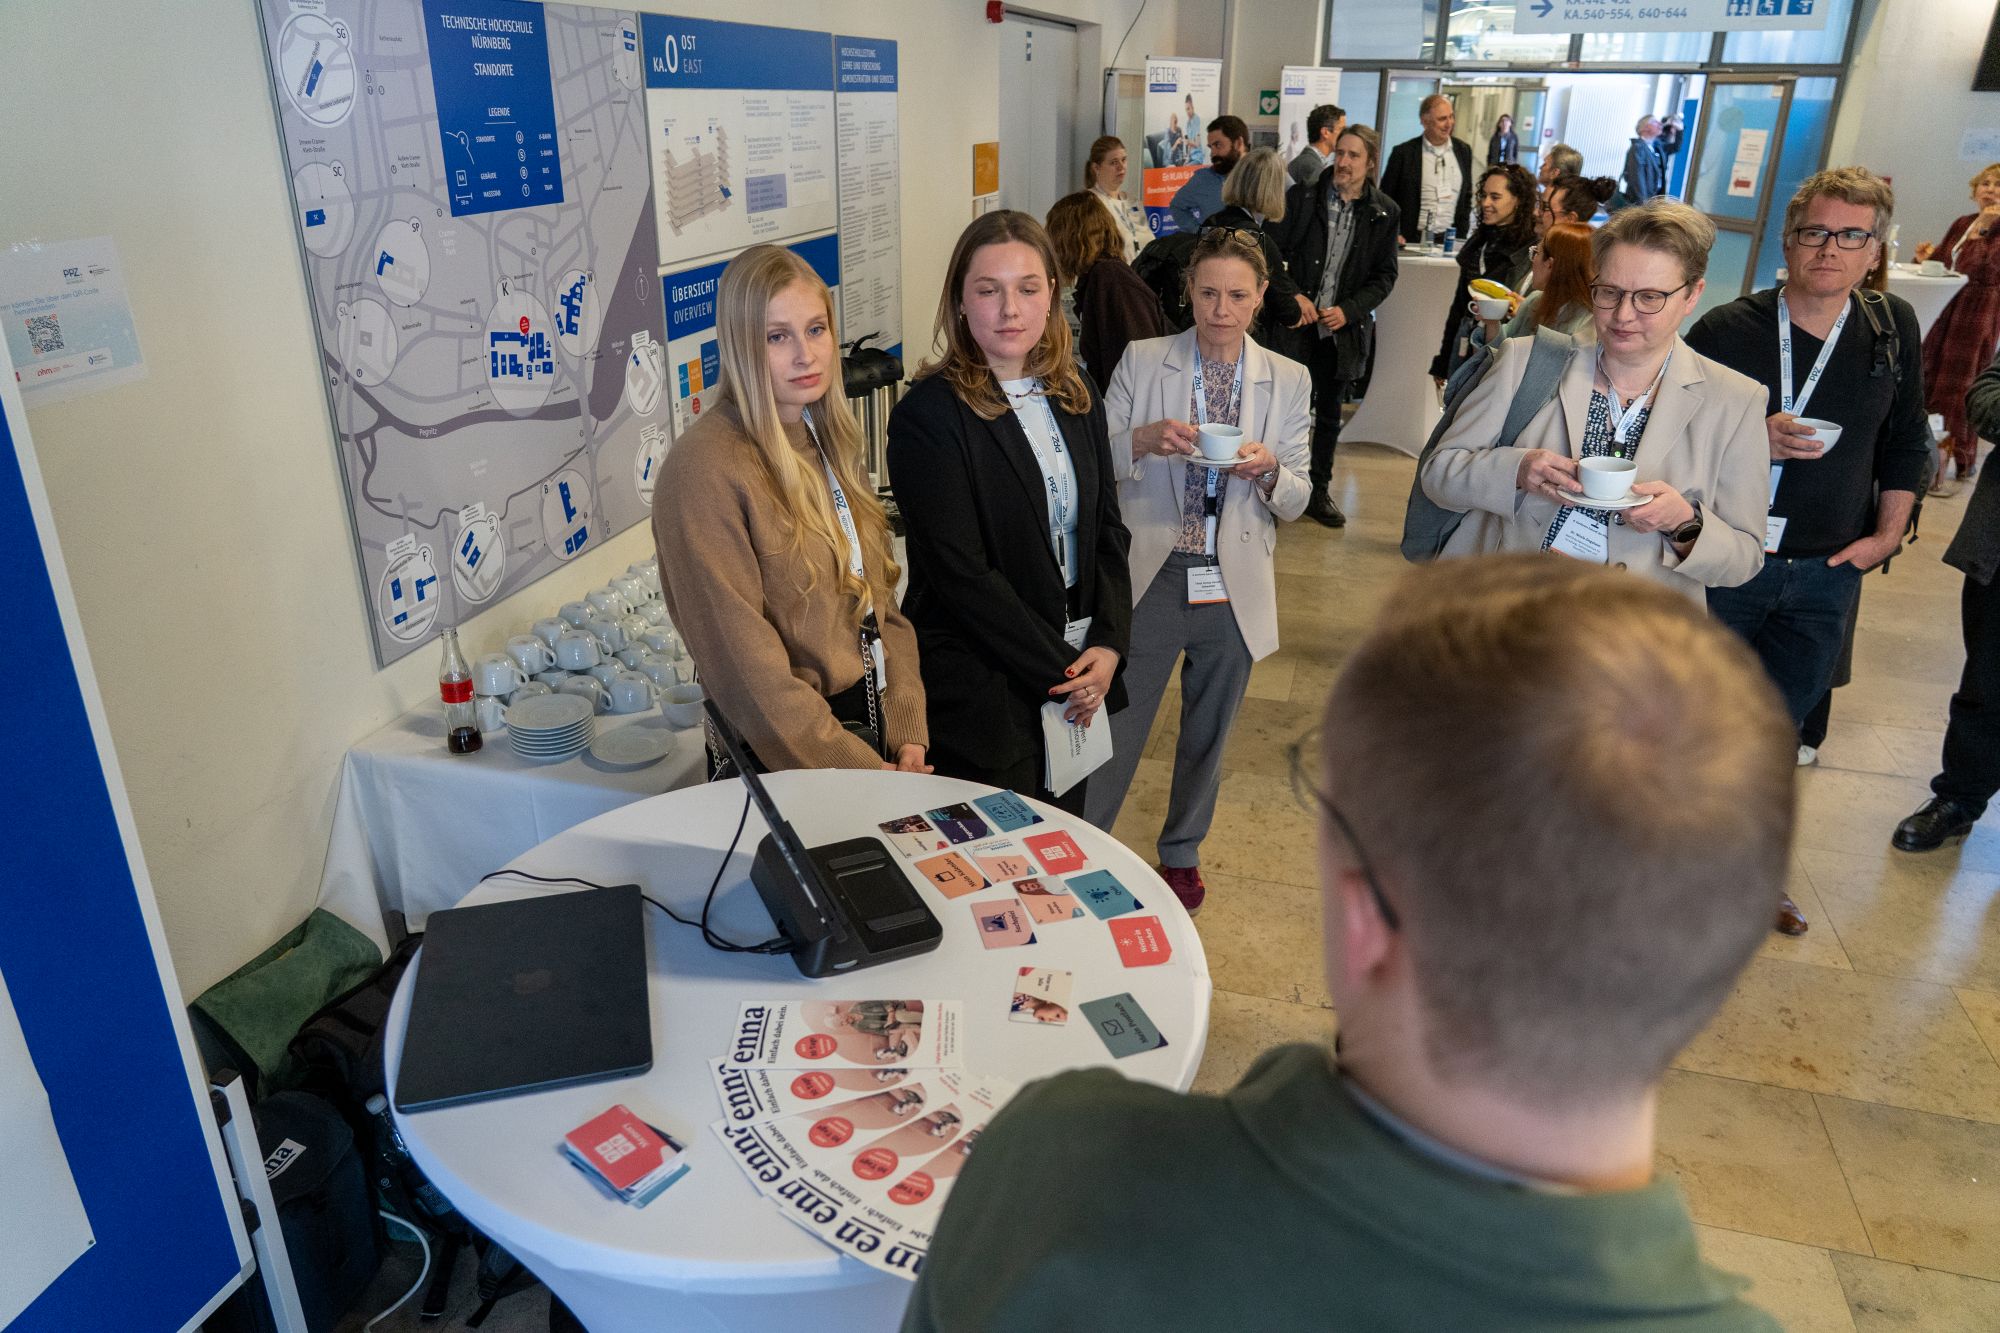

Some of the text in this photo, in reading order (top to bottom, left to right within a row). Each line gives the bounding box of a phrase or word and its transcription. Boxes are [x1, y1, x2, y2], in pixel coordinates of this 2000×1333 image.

[1564, 8, 1687, 20] KA.540-554, 640-644
[441, 15, 533, 34] TECHNISCHE HOCHSCHULE
[472, 34, 511, 50] NÜRNBERG
[681, 35, 696, 50] OST
[474, 63, 514, 76] STANDORTE
[683, 59, 702, 74] EAST
[1149, 66, 1177, 82] PETER
[488, 108, 511, 117] LEGENDE
[333, 167, 342, 177] SC
[412, 223, 419, 232] SP
[502, 282, 509, 297] K
[672, 279, 715, 303] ÜBERSICHT
[674, 302, 712, 325] OVERVIEW
[419, 428, 438, 438] Pegnitz
[944, 858, 976, 888] Mein Kalender
[733, 1006, 765, 1063] enna
[773, 1021, 784, 1038] dabei
[767, 1039, 780, 1064] Einfach
[764, 1088, 780, 1114] Einfach
[783, 1144, 808, 1169] Einfach
[830, 1181, 862, 1205] Einfach
[867, 1207, 904, 1232] Einfach
